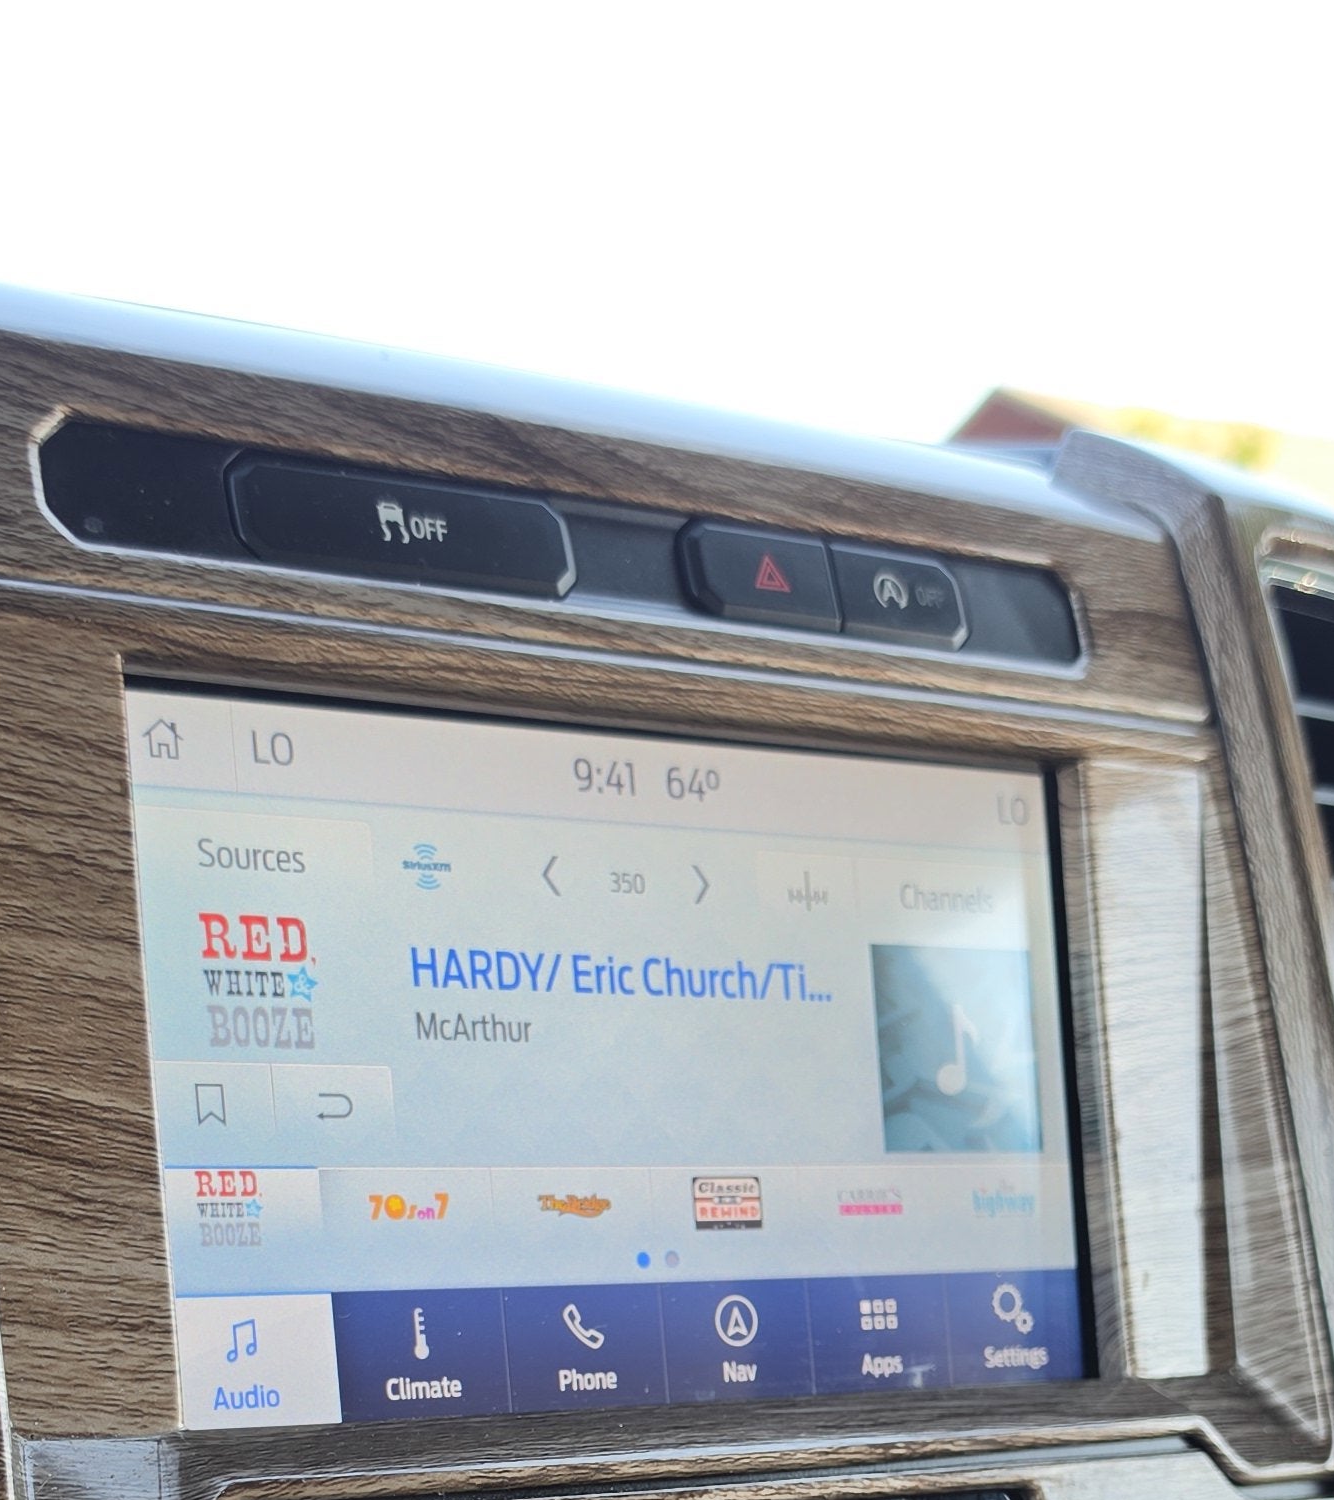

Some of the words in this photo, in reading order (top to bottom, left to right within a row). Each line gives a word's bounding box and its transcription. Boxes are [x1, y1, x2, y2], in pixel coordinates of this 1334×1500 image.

[410, 515, 448, 543] OFF
[251, 730, 295, 766] LO
[573, 758, 636, 796] 9:41
[996, 791, 1030, 827] LO
[197, 838, 306, 874] Sources
[610, 872, 646, 896] 350
[899, 882, 993, 915] Channels
[203, 969, 286, 998] WHITE
[410, 946, 561, 993] HARDY/
[572, 955, 635, 996] Eric
[207, 1004, 316, 1050] BOOZE
[415, 1011, 532, 1044] McArthur
[697, 1179, 757, 1195] Classic
[196, 1202, 245, 1218] WHITE
[698, 1204, 759, 1221] REWIND
[199, 1221, 262, 1247] BOOZE
[861, 1353, 904, 1378] Apps
[983, 1344, 1050, 1370] Settings
[558, 1368, 618, 1392] Phone
[722, 1360, 758, 1383] Nav
[213, 1384, 281, 1411] Audio
[385, 1376, 463, 1401] Climate
